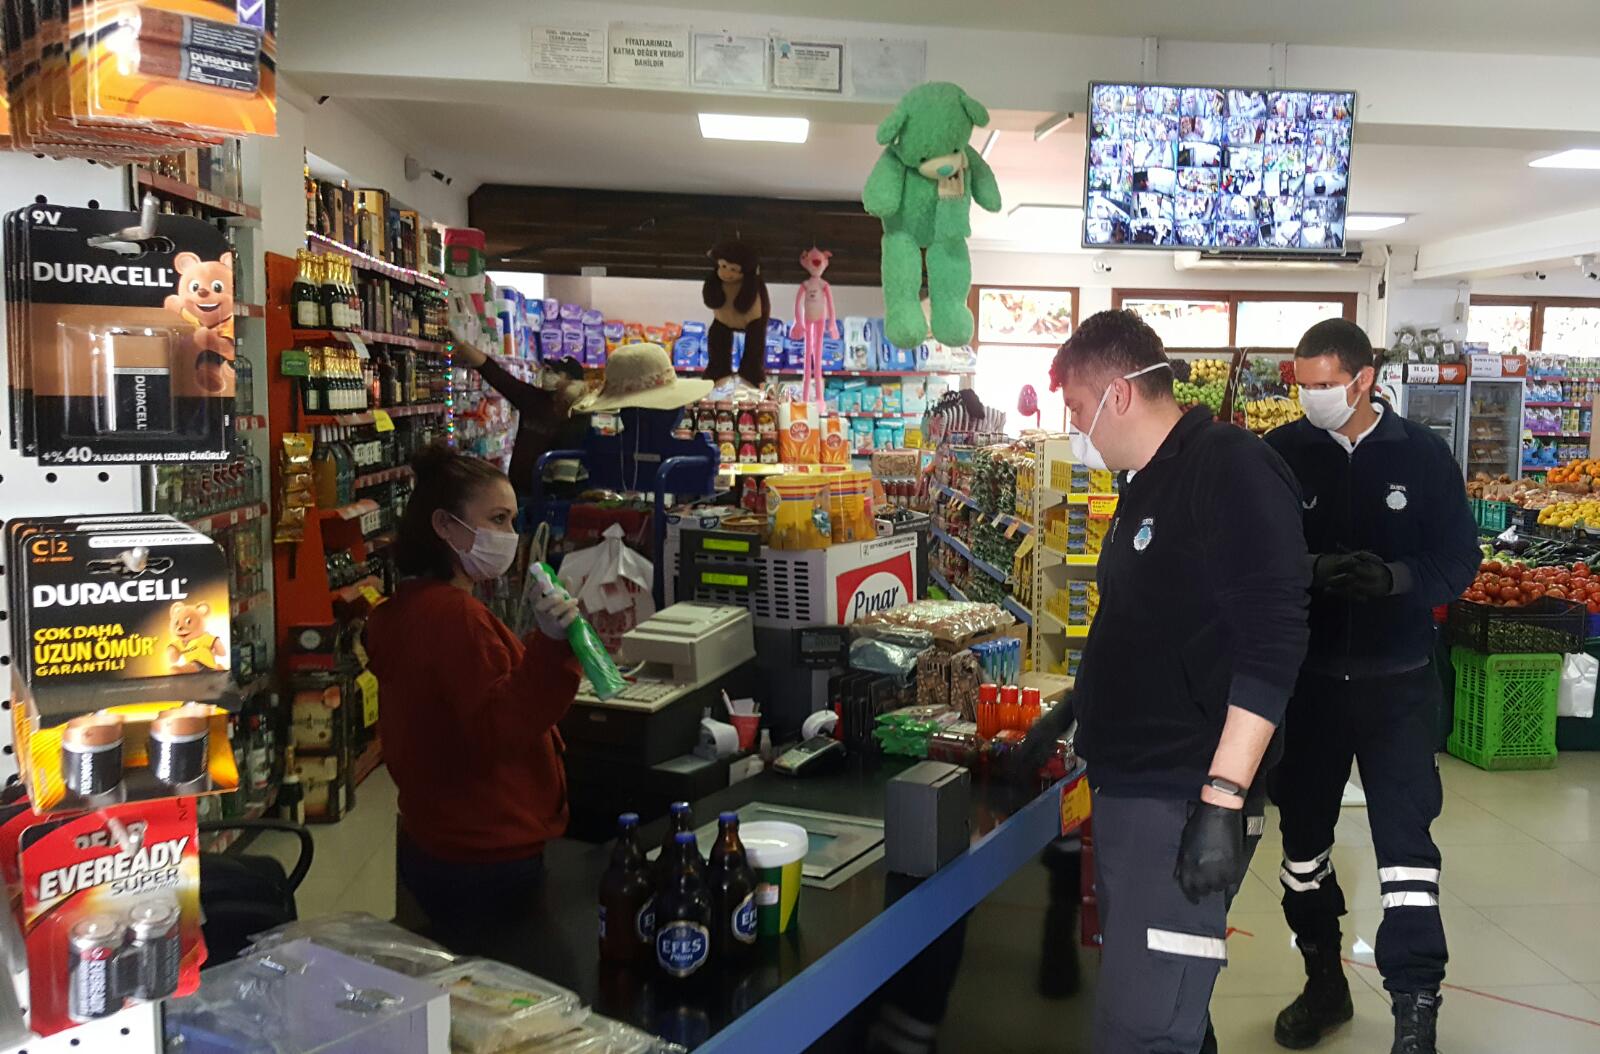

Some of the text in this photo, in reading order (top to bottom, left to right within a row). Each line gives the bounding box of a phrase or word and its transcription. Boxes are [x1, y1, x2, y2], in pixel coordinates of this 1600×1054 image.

[190, 51, 252, 72] DURACELL
[613, 46, 635, 56] KATMA
[32, 210, 62, 226] 9V
[33, 261, 174, 288] DURACELL
[134, 375, 148, 430] DURACELL
[102, 451, 135, 462] KADAR
[135, 451, 163, 462] DAHA
[163, 451, 189, 461] UZUN
[33, 578, 188, 608] DURACELL
[34, 623, 124, 645] ÇOK DAHA
[34, 640, 92, 665] UZUN
[35, 658, 125, 677] GARANTİLİ
[39, 836, 190, 901] EVEREADY
[111, 867, 178, 896] SUPER
[662, 938, 701, 953] EFES
